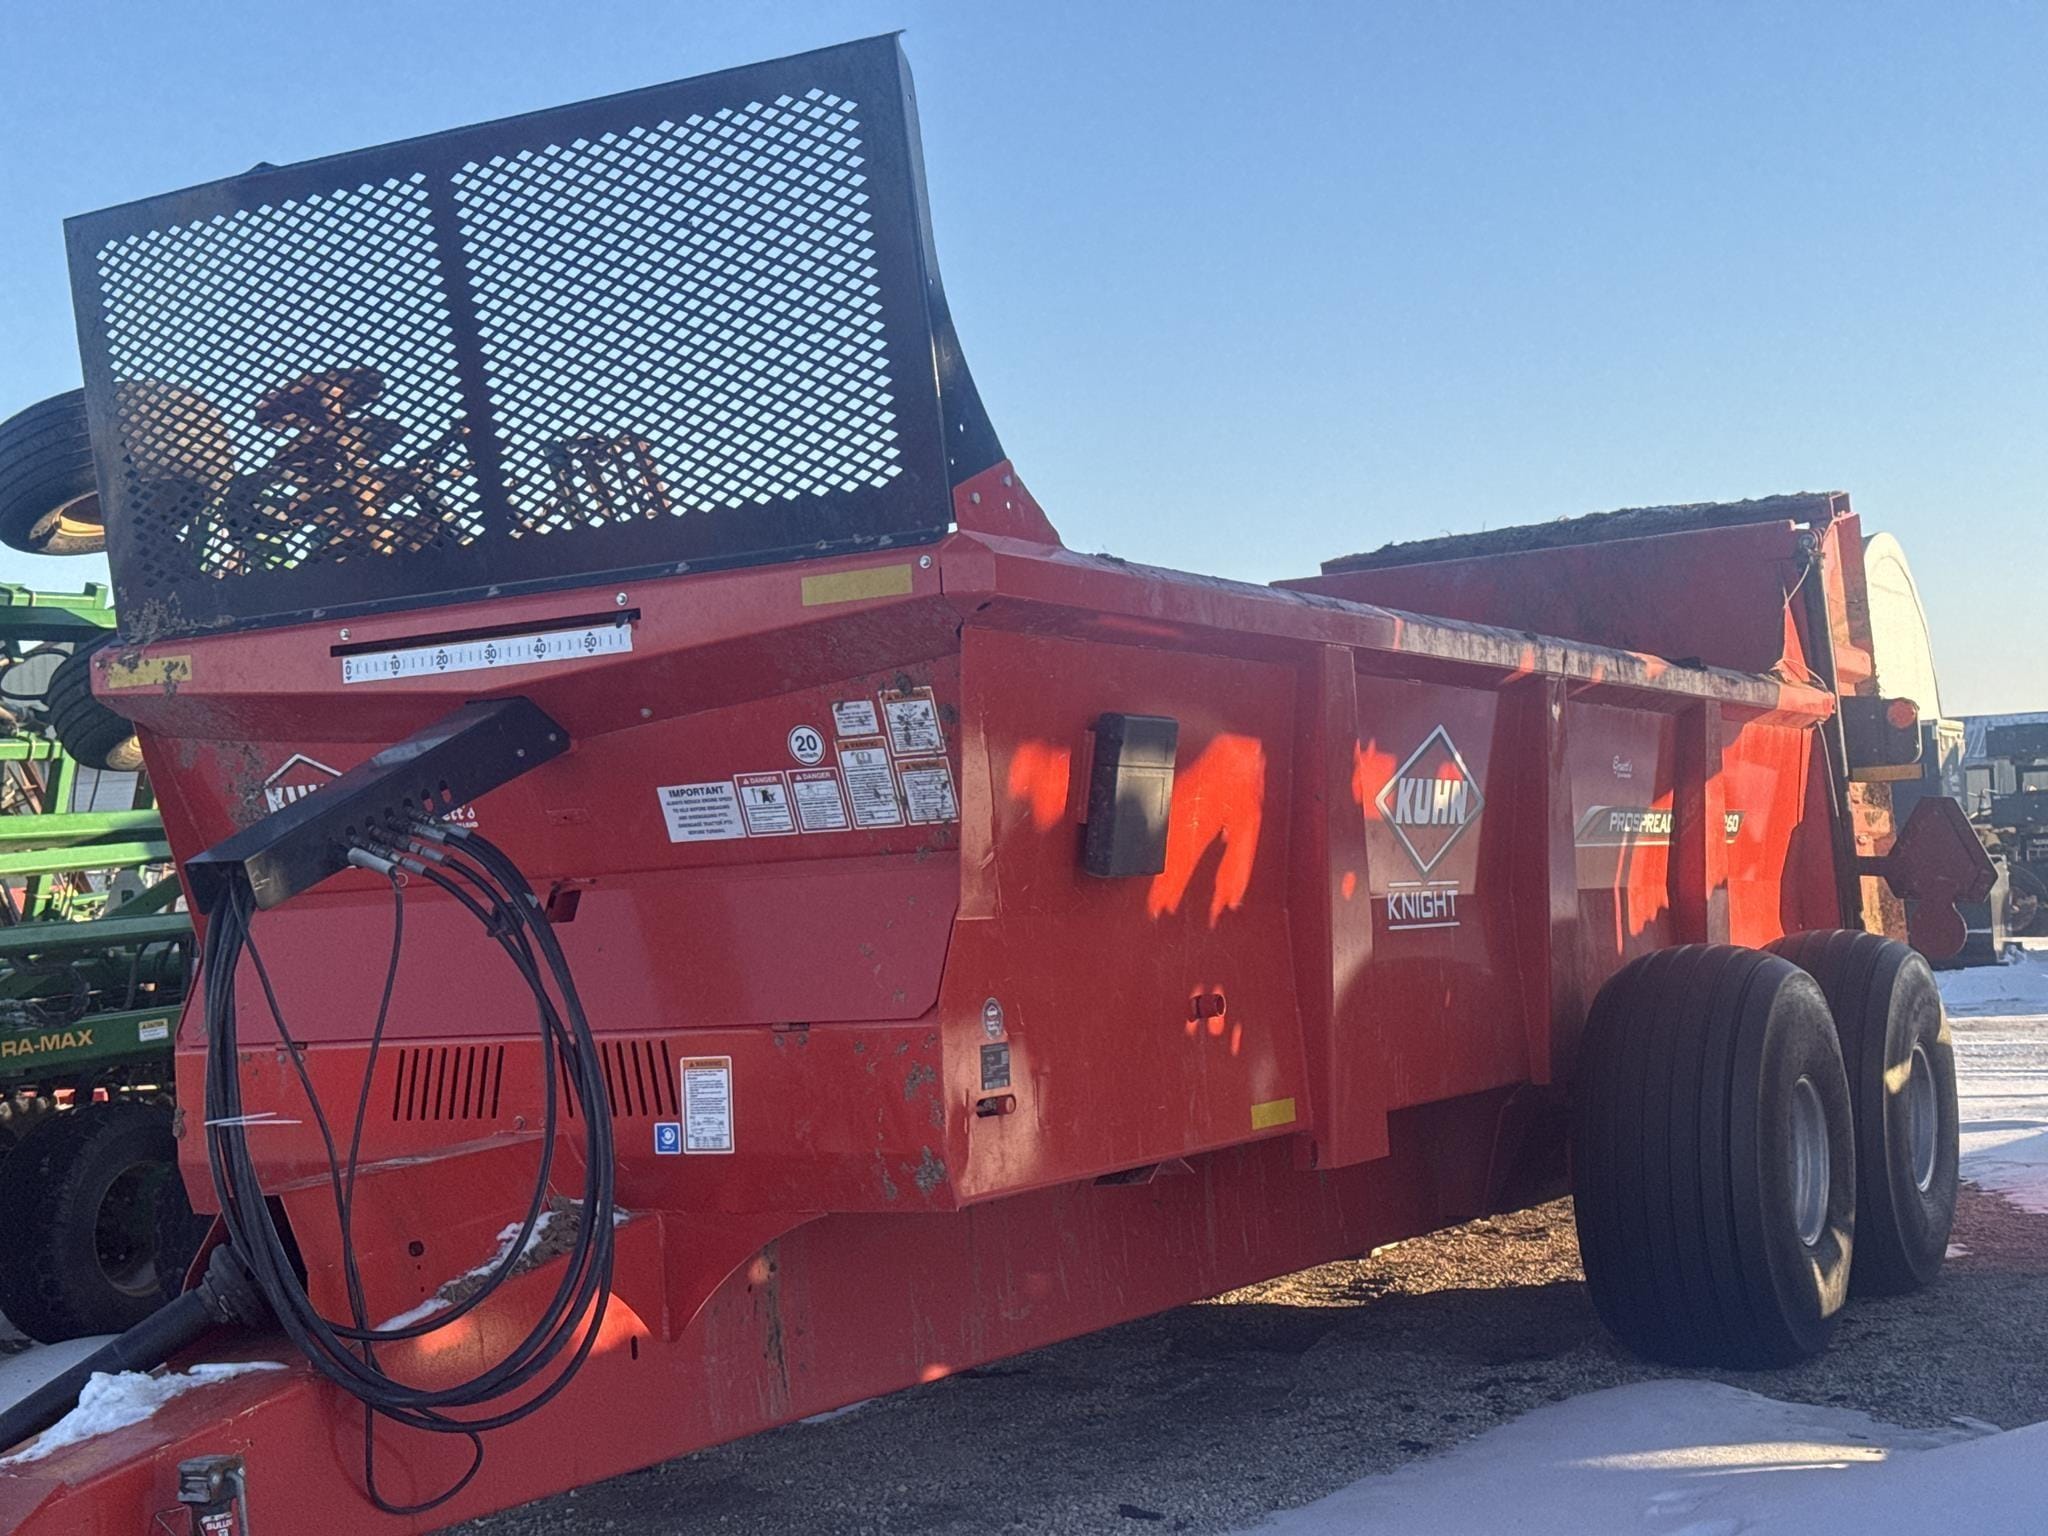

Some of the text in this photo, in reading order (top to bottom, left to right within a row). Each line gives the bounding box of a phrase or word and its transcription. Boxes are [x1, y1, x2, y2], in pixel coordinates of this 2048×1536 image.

[345, 636, 597, 675] 0 10 20 30 40 50
[796, 735, 818, 751] 20
[750, 776, 777, 784] DANGER
[802, 772, 831, 780] DANGER
[668, 786, 724, 798] IMPORTANT
[1395, 778, 1468, 826] KUHN
[1388, 890, 1458, 920] KNIGHT
